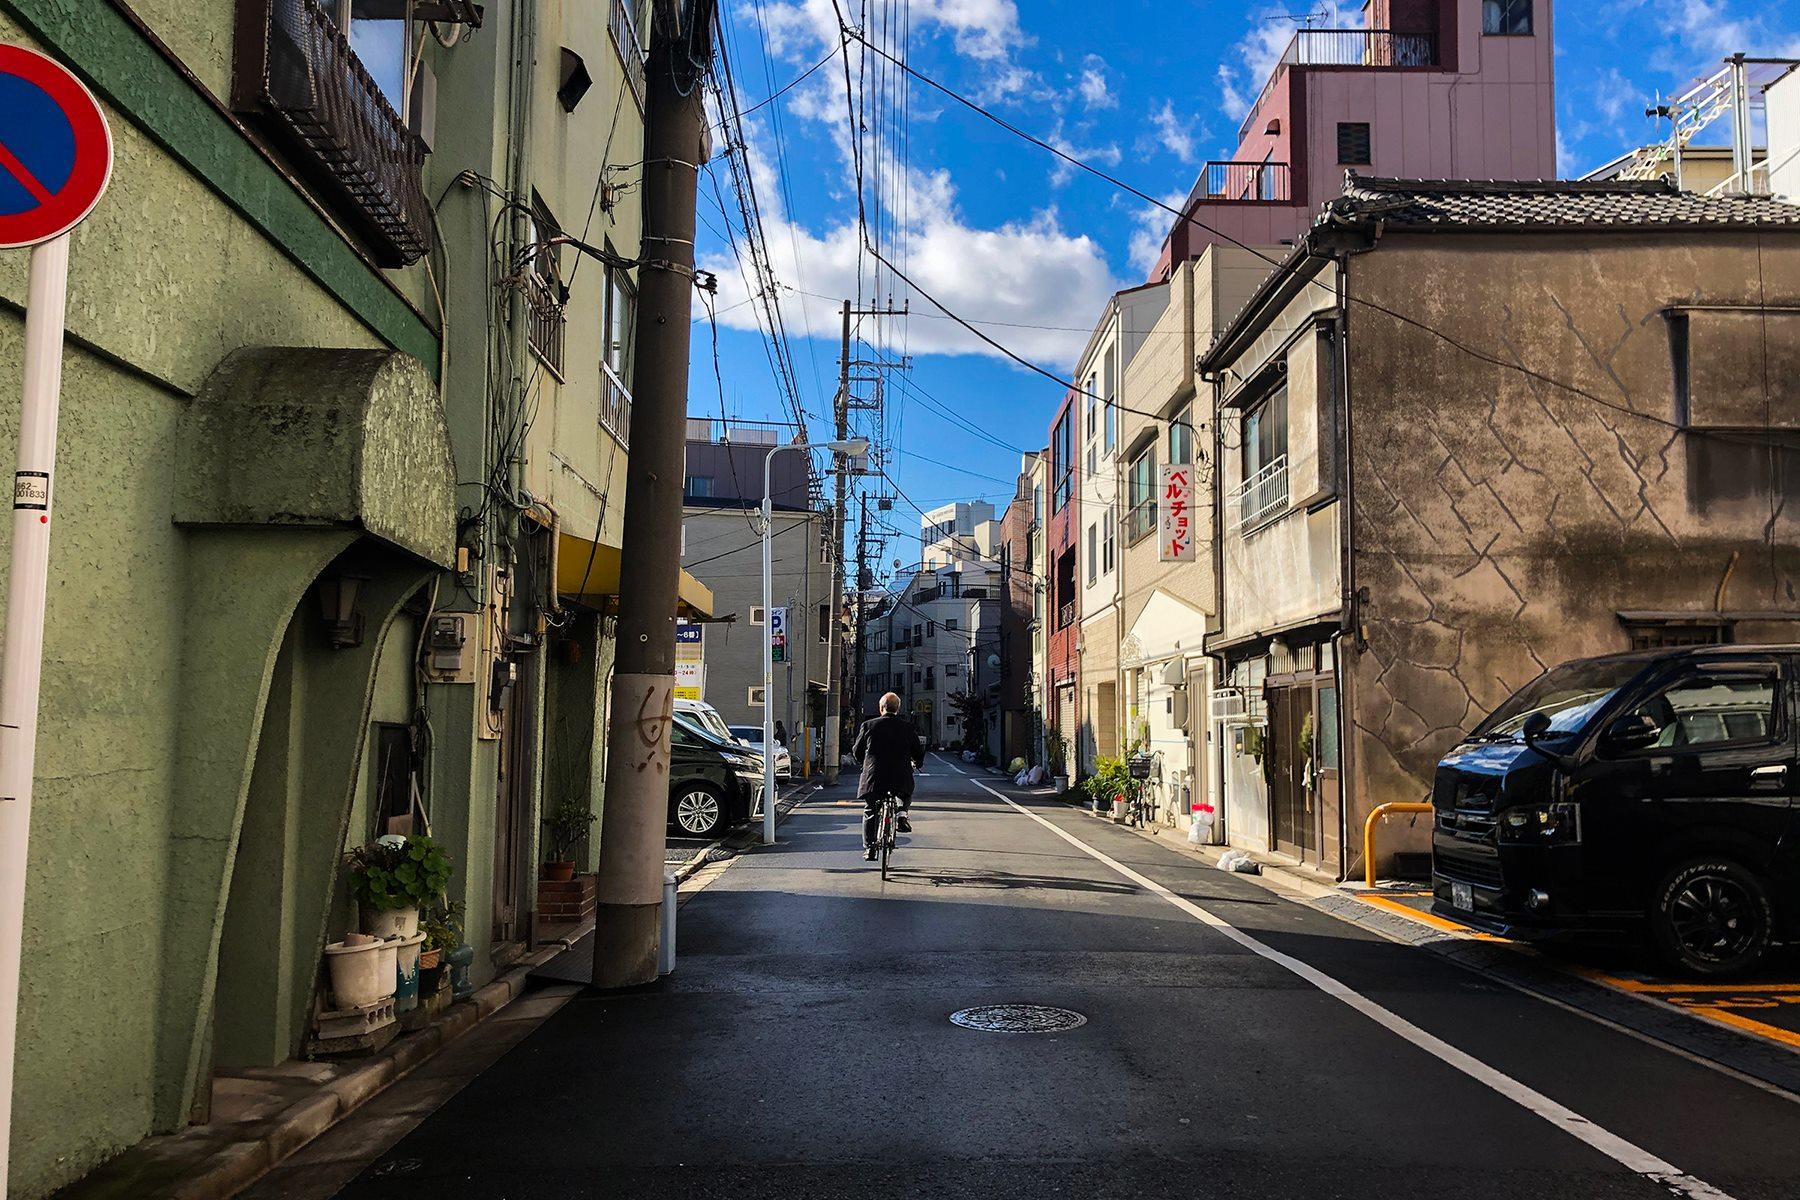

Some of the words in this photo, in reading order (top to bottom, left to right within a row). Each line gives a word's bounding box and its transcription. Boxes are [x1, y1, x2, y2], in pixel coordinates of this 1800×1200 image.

[1165, 470, 1188, 557] ベルチョット
[771, 616, 781, 634] P
